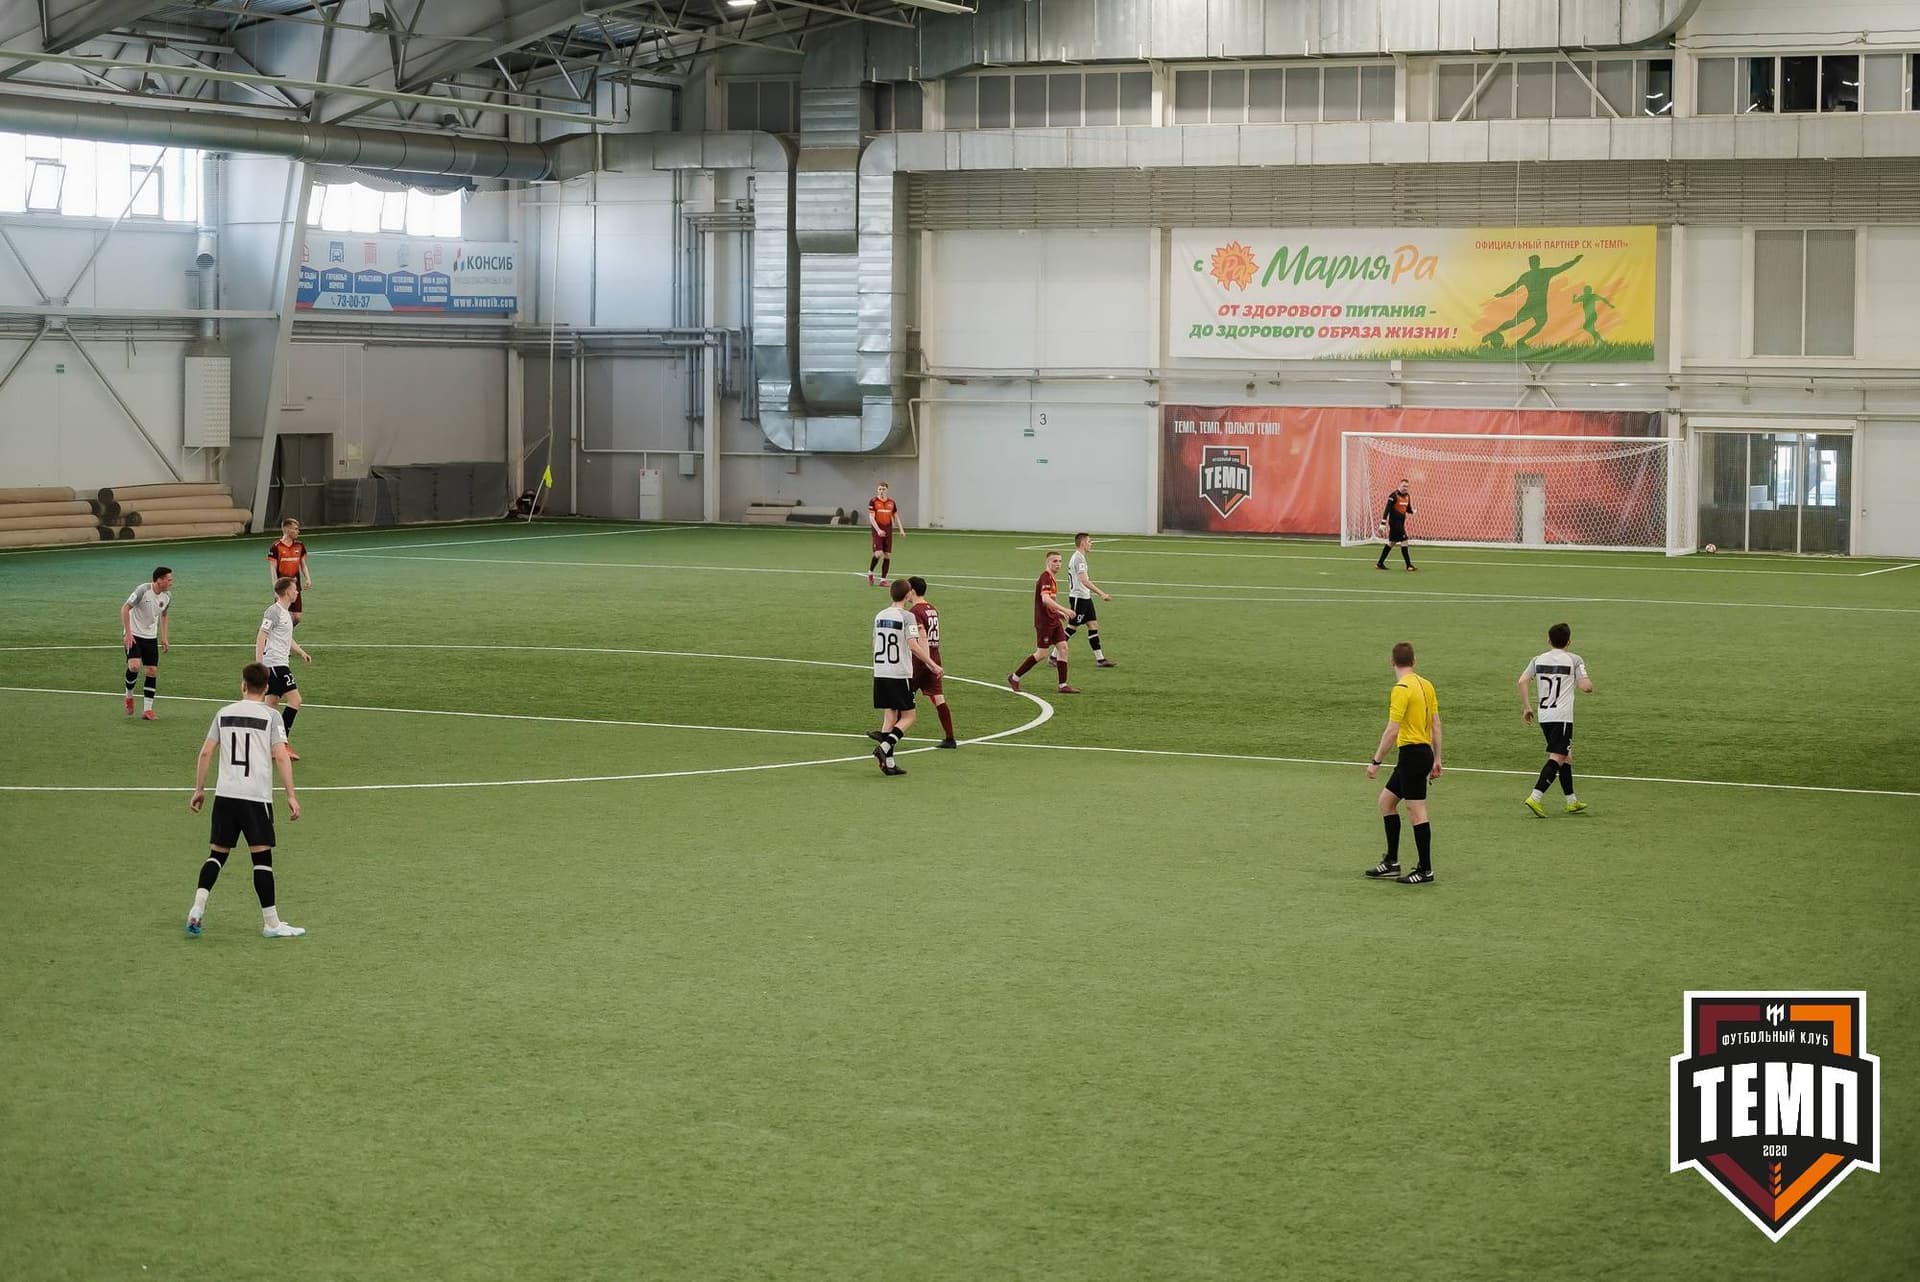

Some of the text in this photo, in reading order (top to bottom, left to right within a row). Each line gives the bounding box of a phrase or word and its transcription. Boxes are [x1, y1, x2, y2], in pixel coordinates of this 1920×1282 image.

[1475, 238, 1542, 251] ОФИЦИАЛЬНЫЙ
[1544, 239, 1580, 250] ПАРТНЕР
[1581, 239, 1592, 249] СК
[467, 255, 513, 270] КОНСИБ
[1218, 304, 1240, 317] ОТ
[1242, 304, 1342, 319] ЗДОРОВОГО
[1345, 304, 1427, 318] ПИТАНИЯ
[1189, 323, 1214, 339] ДО
[1216, 324, 1315, 339] ЗДОРОВОГО
[1318, 325, 1381, 339] ОБРАЗА
[1039, 412, 1048, 426] 3
[1174, 420, 1198, 435] ТЕМП,
[1224, 421, 1255, 436] ТОЛЬКО
[1256, 422, 1281, 436] ТЕМП!
[1204, 465, 1248, 491] ТЕМП
[875, 632, 900, 664] 28
[1539, 676, 1562, 709] 21
[231, 732, 251, 777] 4
